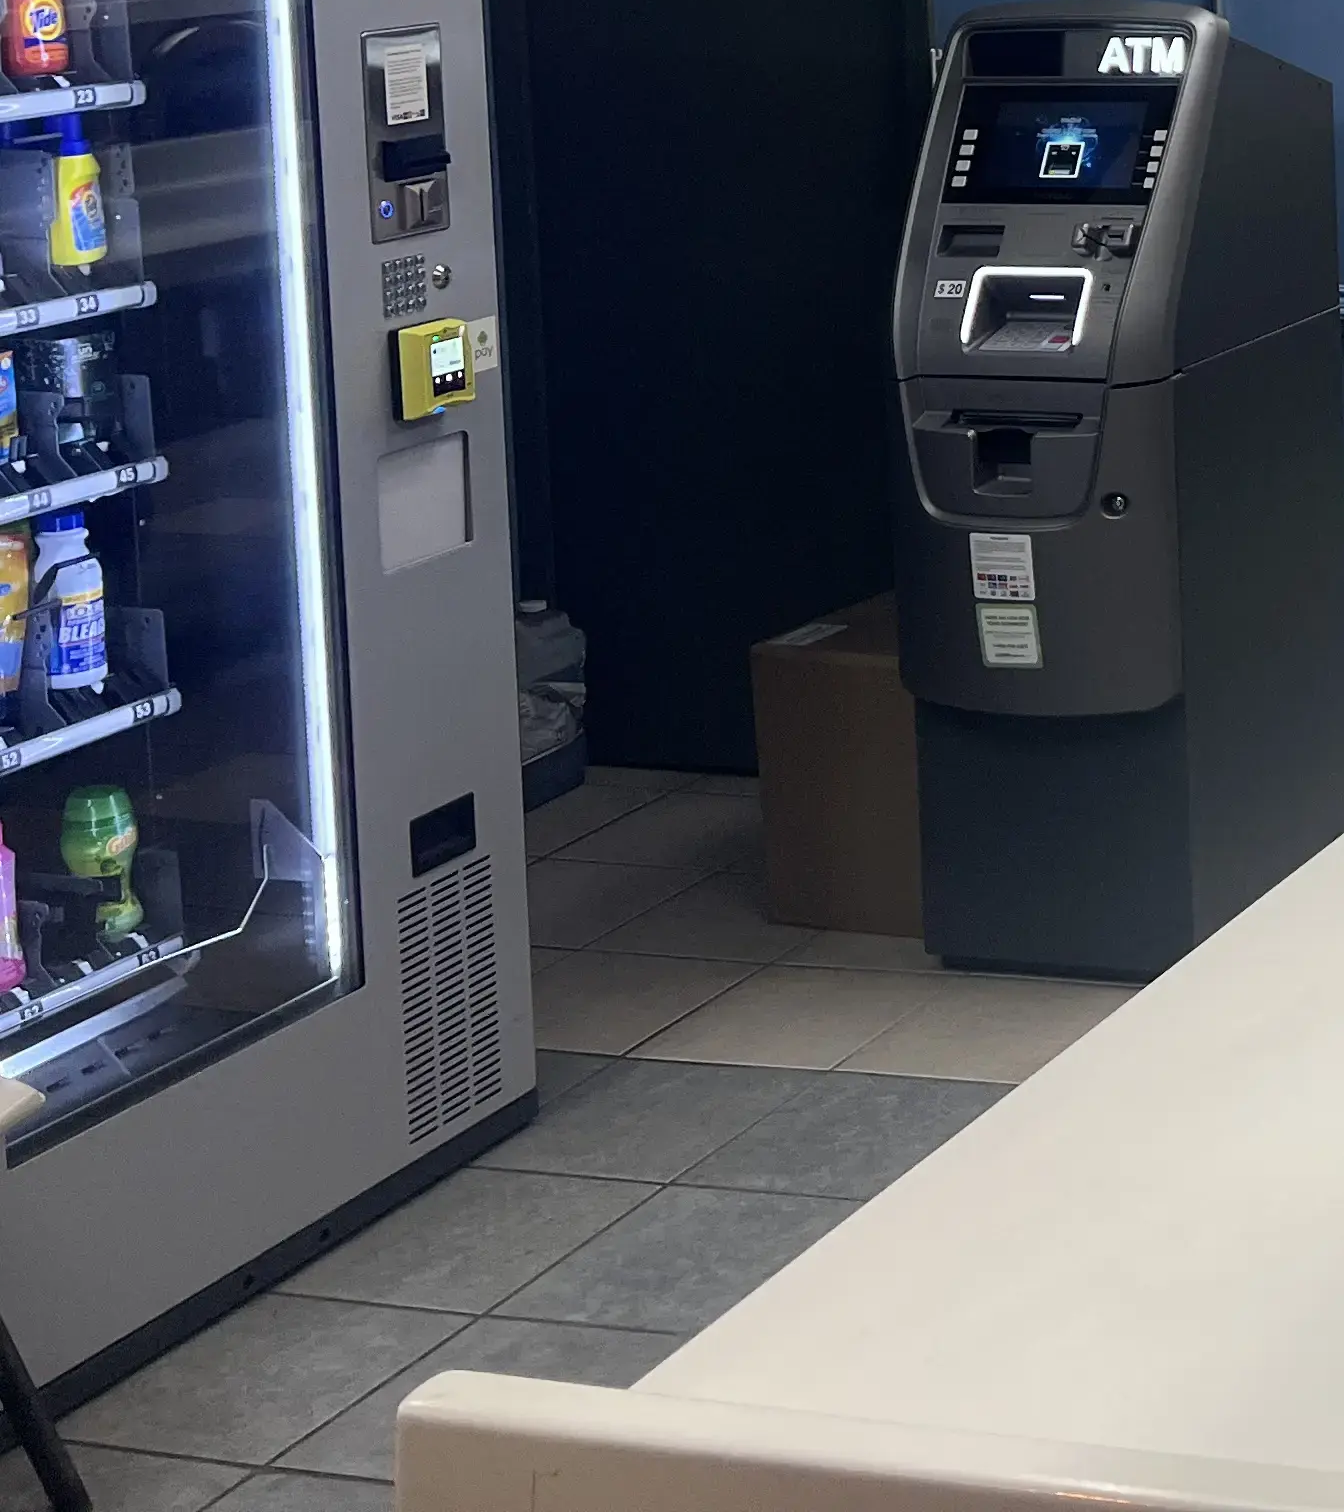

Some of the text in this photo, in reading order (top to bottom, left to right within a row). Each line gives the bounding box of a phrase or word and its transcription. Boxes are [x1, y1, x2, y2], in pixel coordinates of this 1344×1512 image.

[29, 7, 59, 34] Tide
[1098, 36, 1186, 74] ATM
[76, 89, 94, 104] 23
[936, 283, 963, 296] $ 20
[18, 296, 97, 326] 33 34
[475, 345, 494, 361] pay
[58, 617, 106, 645] BLEAC
[1, 701, 152, 769] 52 53
